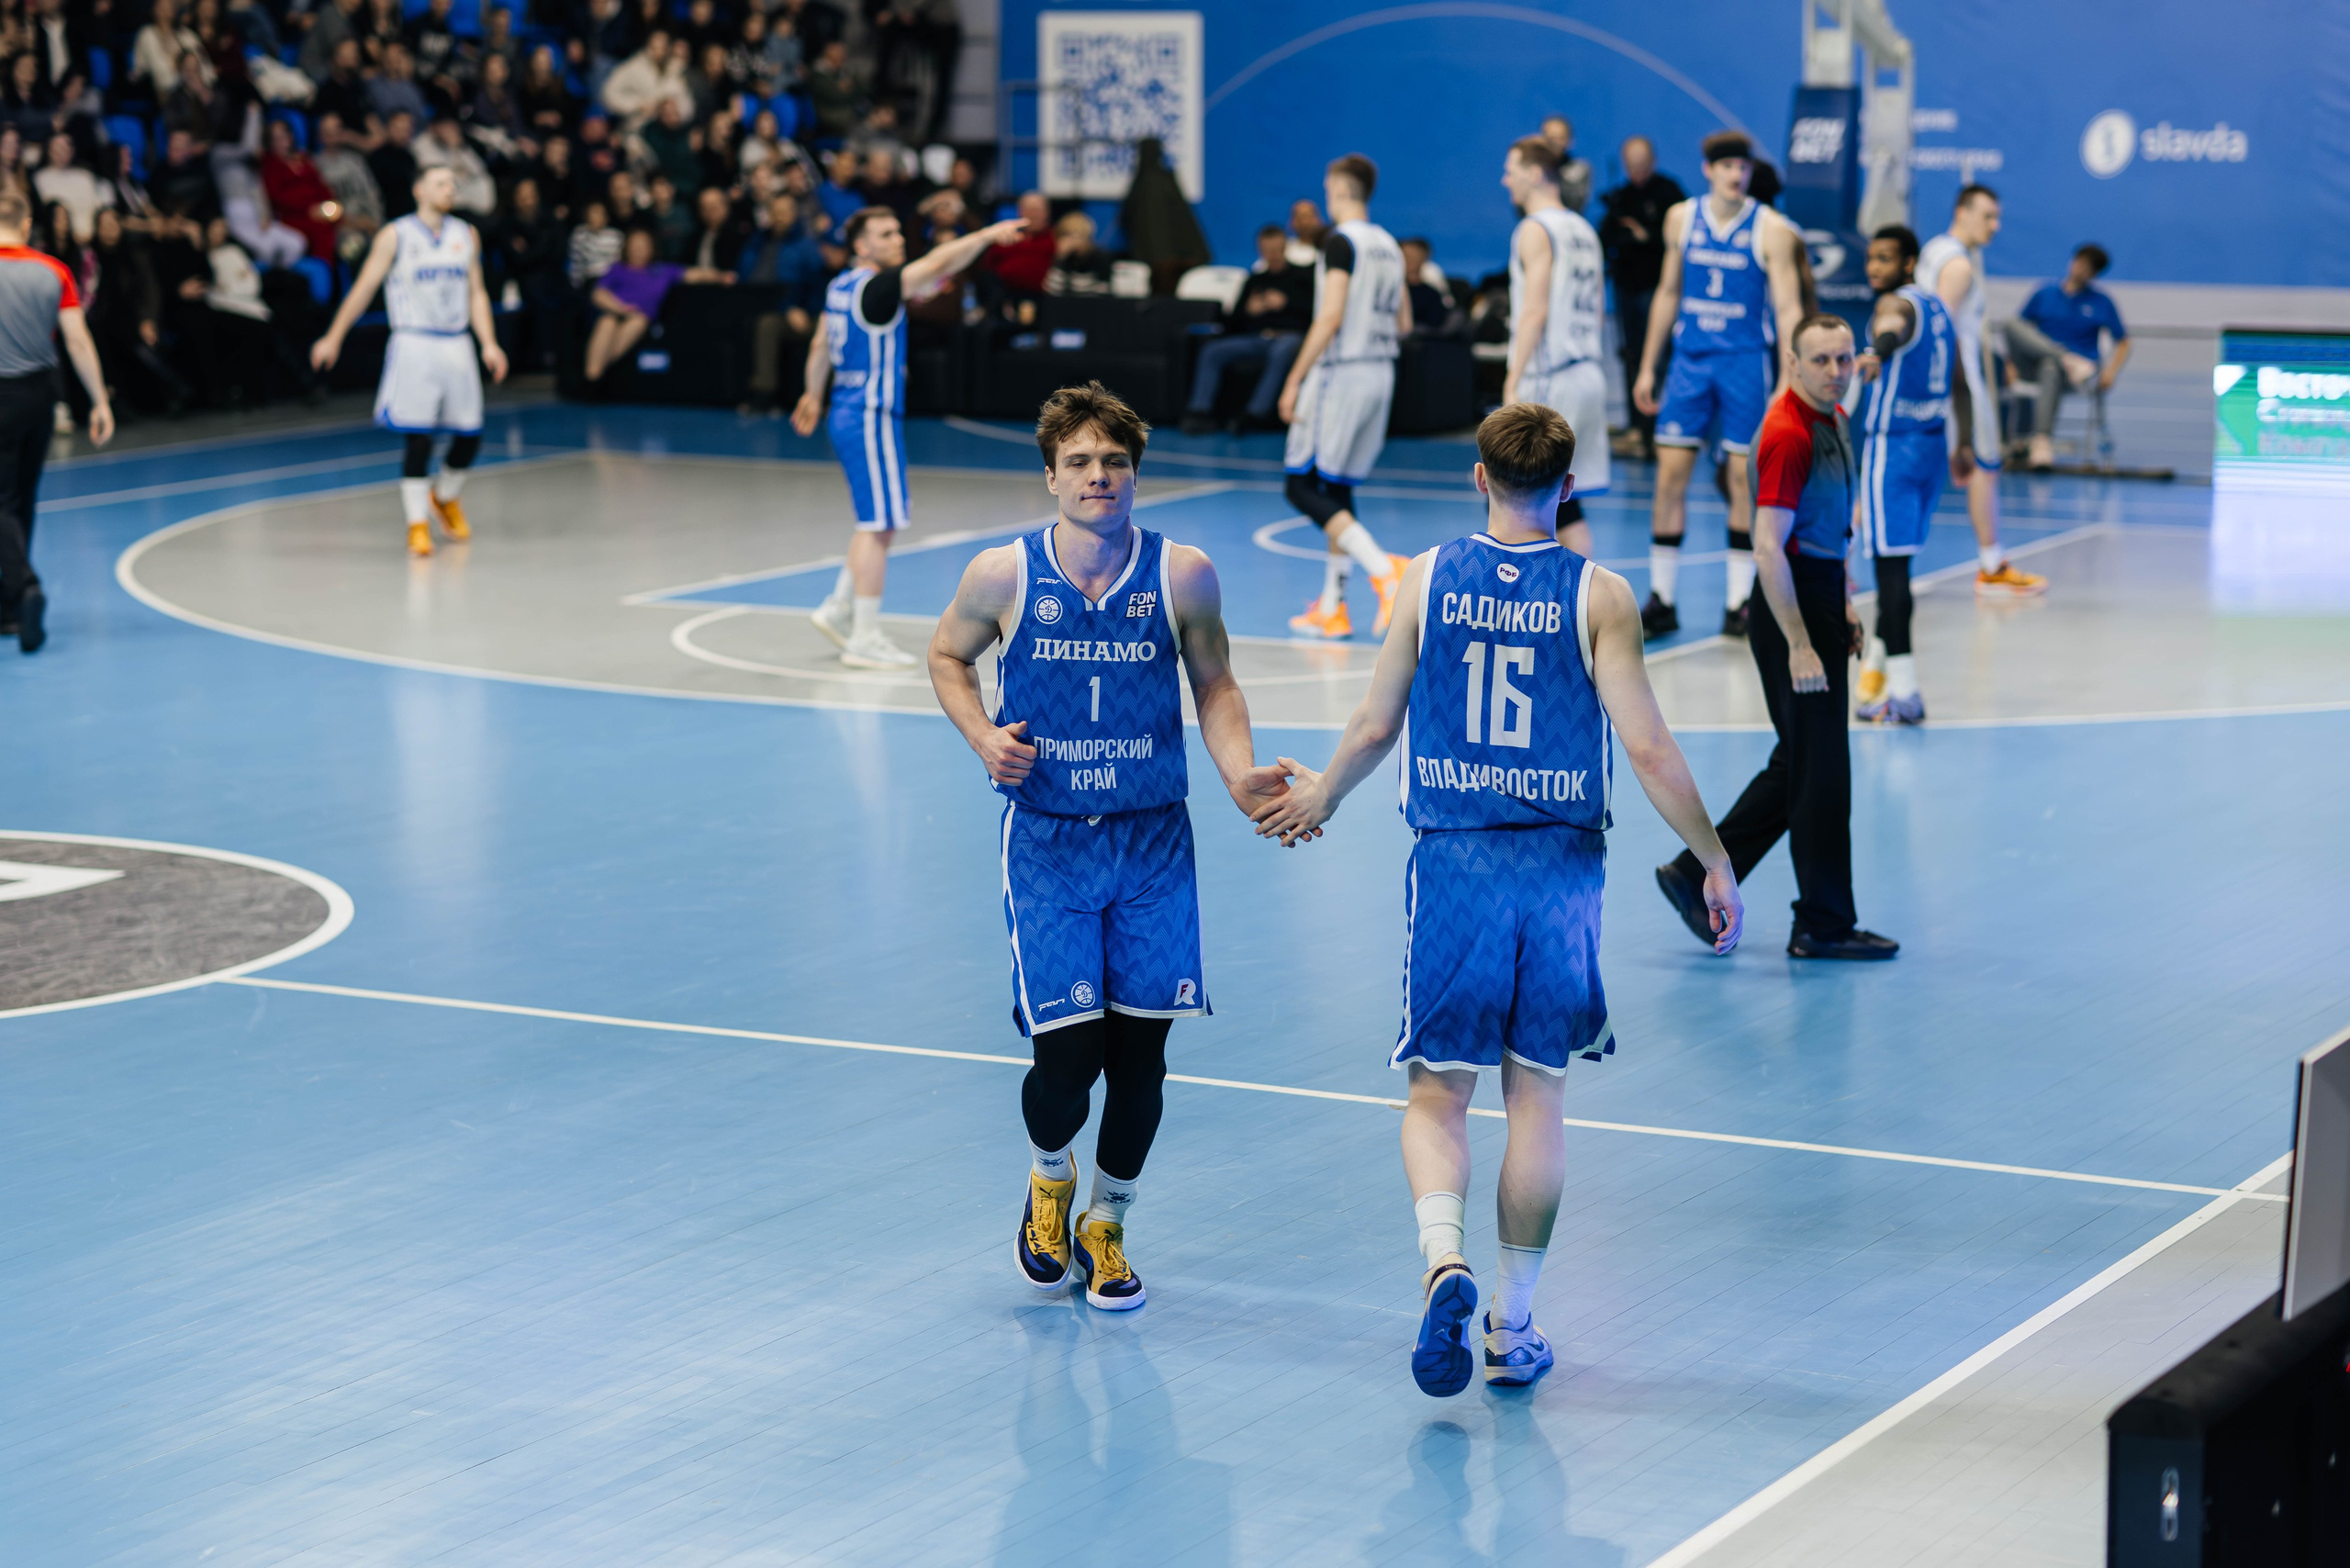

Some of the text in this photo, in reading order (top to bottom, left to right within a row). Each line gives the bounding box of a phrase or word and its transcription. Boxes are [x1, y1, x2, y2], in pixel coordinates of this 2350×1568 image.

[2141, 120, 2247, 162] slavda
[1125, 603, 1156, 618] BET
[1128, 590, 1157, 605] FON
[1442, 592, 1561, 633] САДИКОВ
[1032, 637, 1157, 662] ДИНАМО
[1089, 676, 1101, 722] 1
[1461, 641, 1535, 748] 16
[1034, 734, 1153, 762] ПРИМОРСКИЙ
[1070, 762, 1117, 790] КРАЙ
[1416, 756, 1588, 801] ВЛАДИВОСТОК
